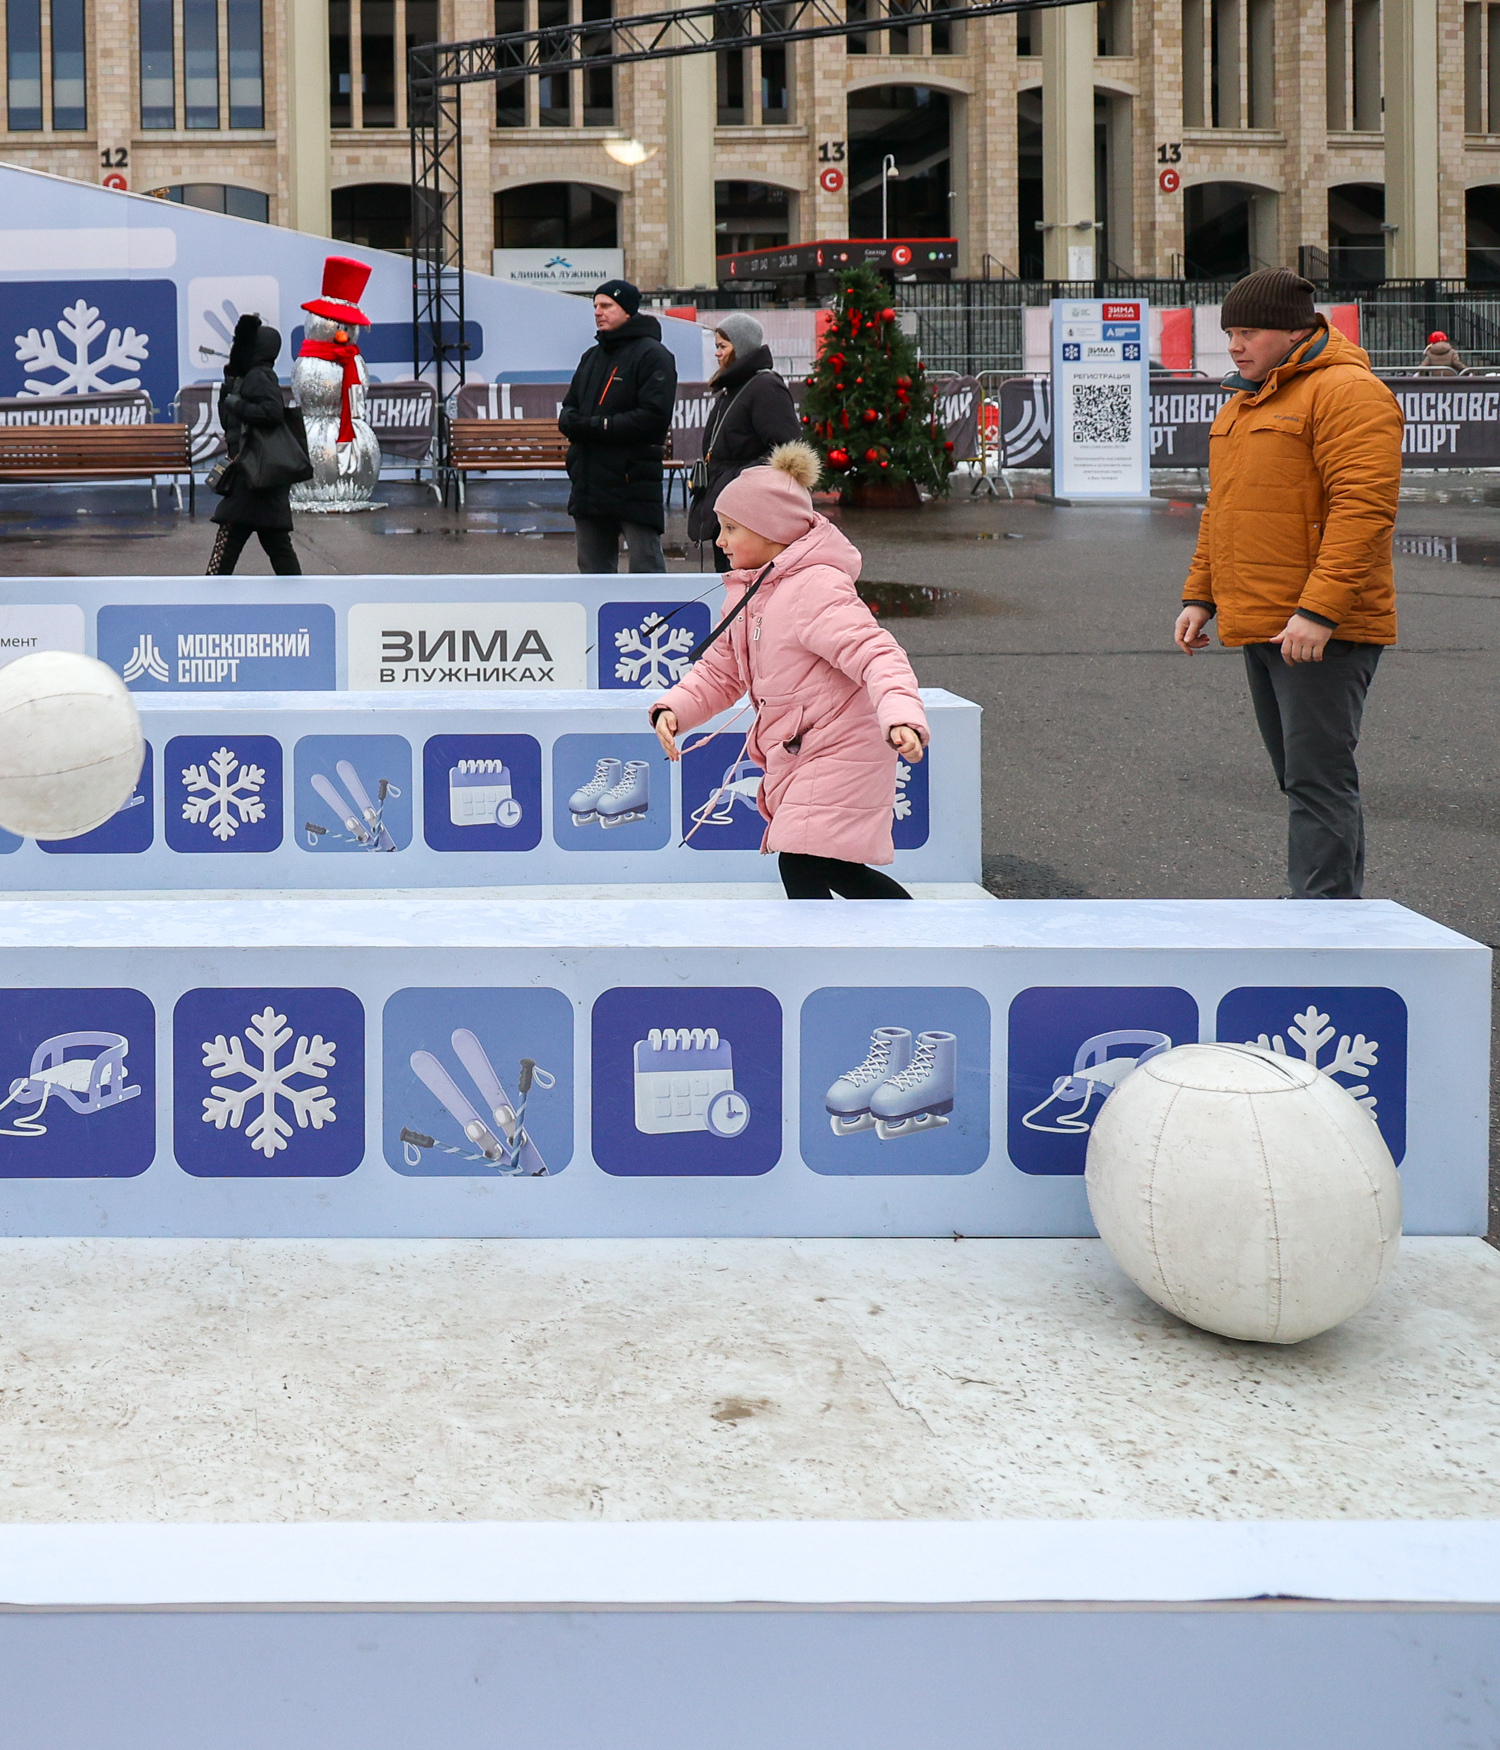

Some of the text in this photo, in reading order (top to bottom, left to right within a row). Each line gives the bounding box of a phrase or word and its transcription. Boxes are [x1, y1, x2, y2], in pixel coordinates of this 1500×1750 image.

[101, 147, 128, 167] 12
[819, 142, 845, 161] 13
[1158, 143, 1182, 163] 13
[510, 270, 607, 279] КЛИНИКА ЛУЖНИКИ
[1396, 392, 1499, 421] ОСКОВС
[1401, 424, 1461, 453] ПОРТ
[178, 628, 310, 658] МОСКОВСКИЙ
[381, 630, 554, 662] ЗИМА
[178, 659, 240, 683] СПОРТ
[380, 667, 555, 682] В ЛУЖНИКАХ
